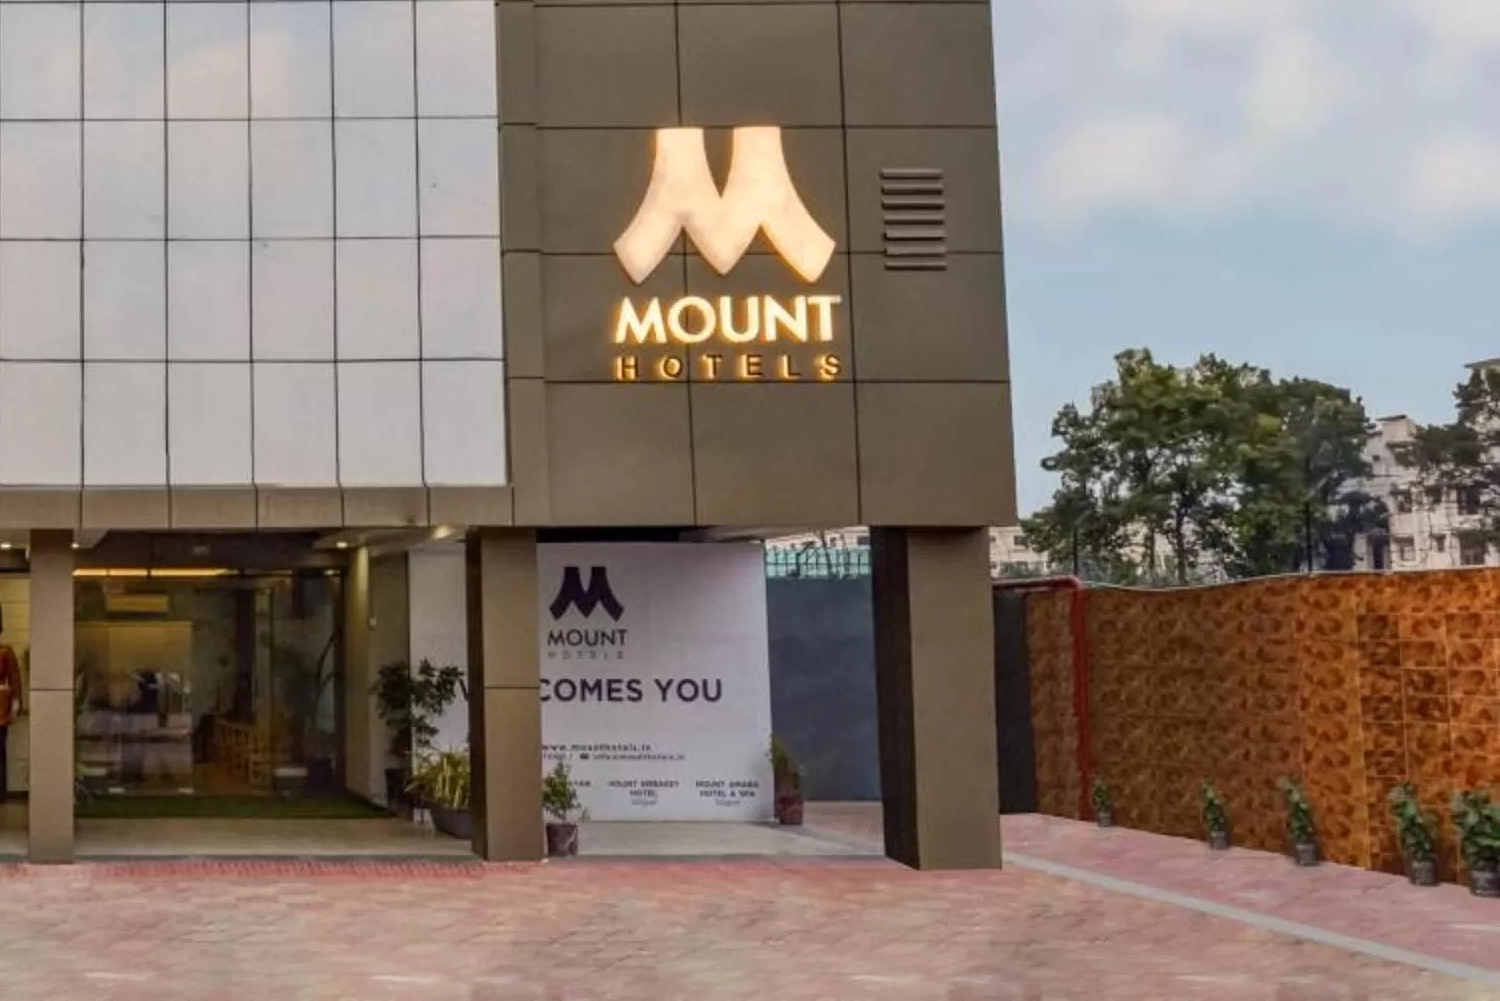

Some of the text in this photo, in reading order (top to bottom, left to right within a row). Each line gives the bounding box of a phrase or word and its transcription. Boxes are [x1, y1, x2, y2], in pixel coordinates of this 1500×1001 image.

[614, 295, 842, 344] MOUNT
[616, 354, 841, 380] HOTELS
[547, 629, 628, 646] MOUNT
[654, 679, 722, 702] YOU
